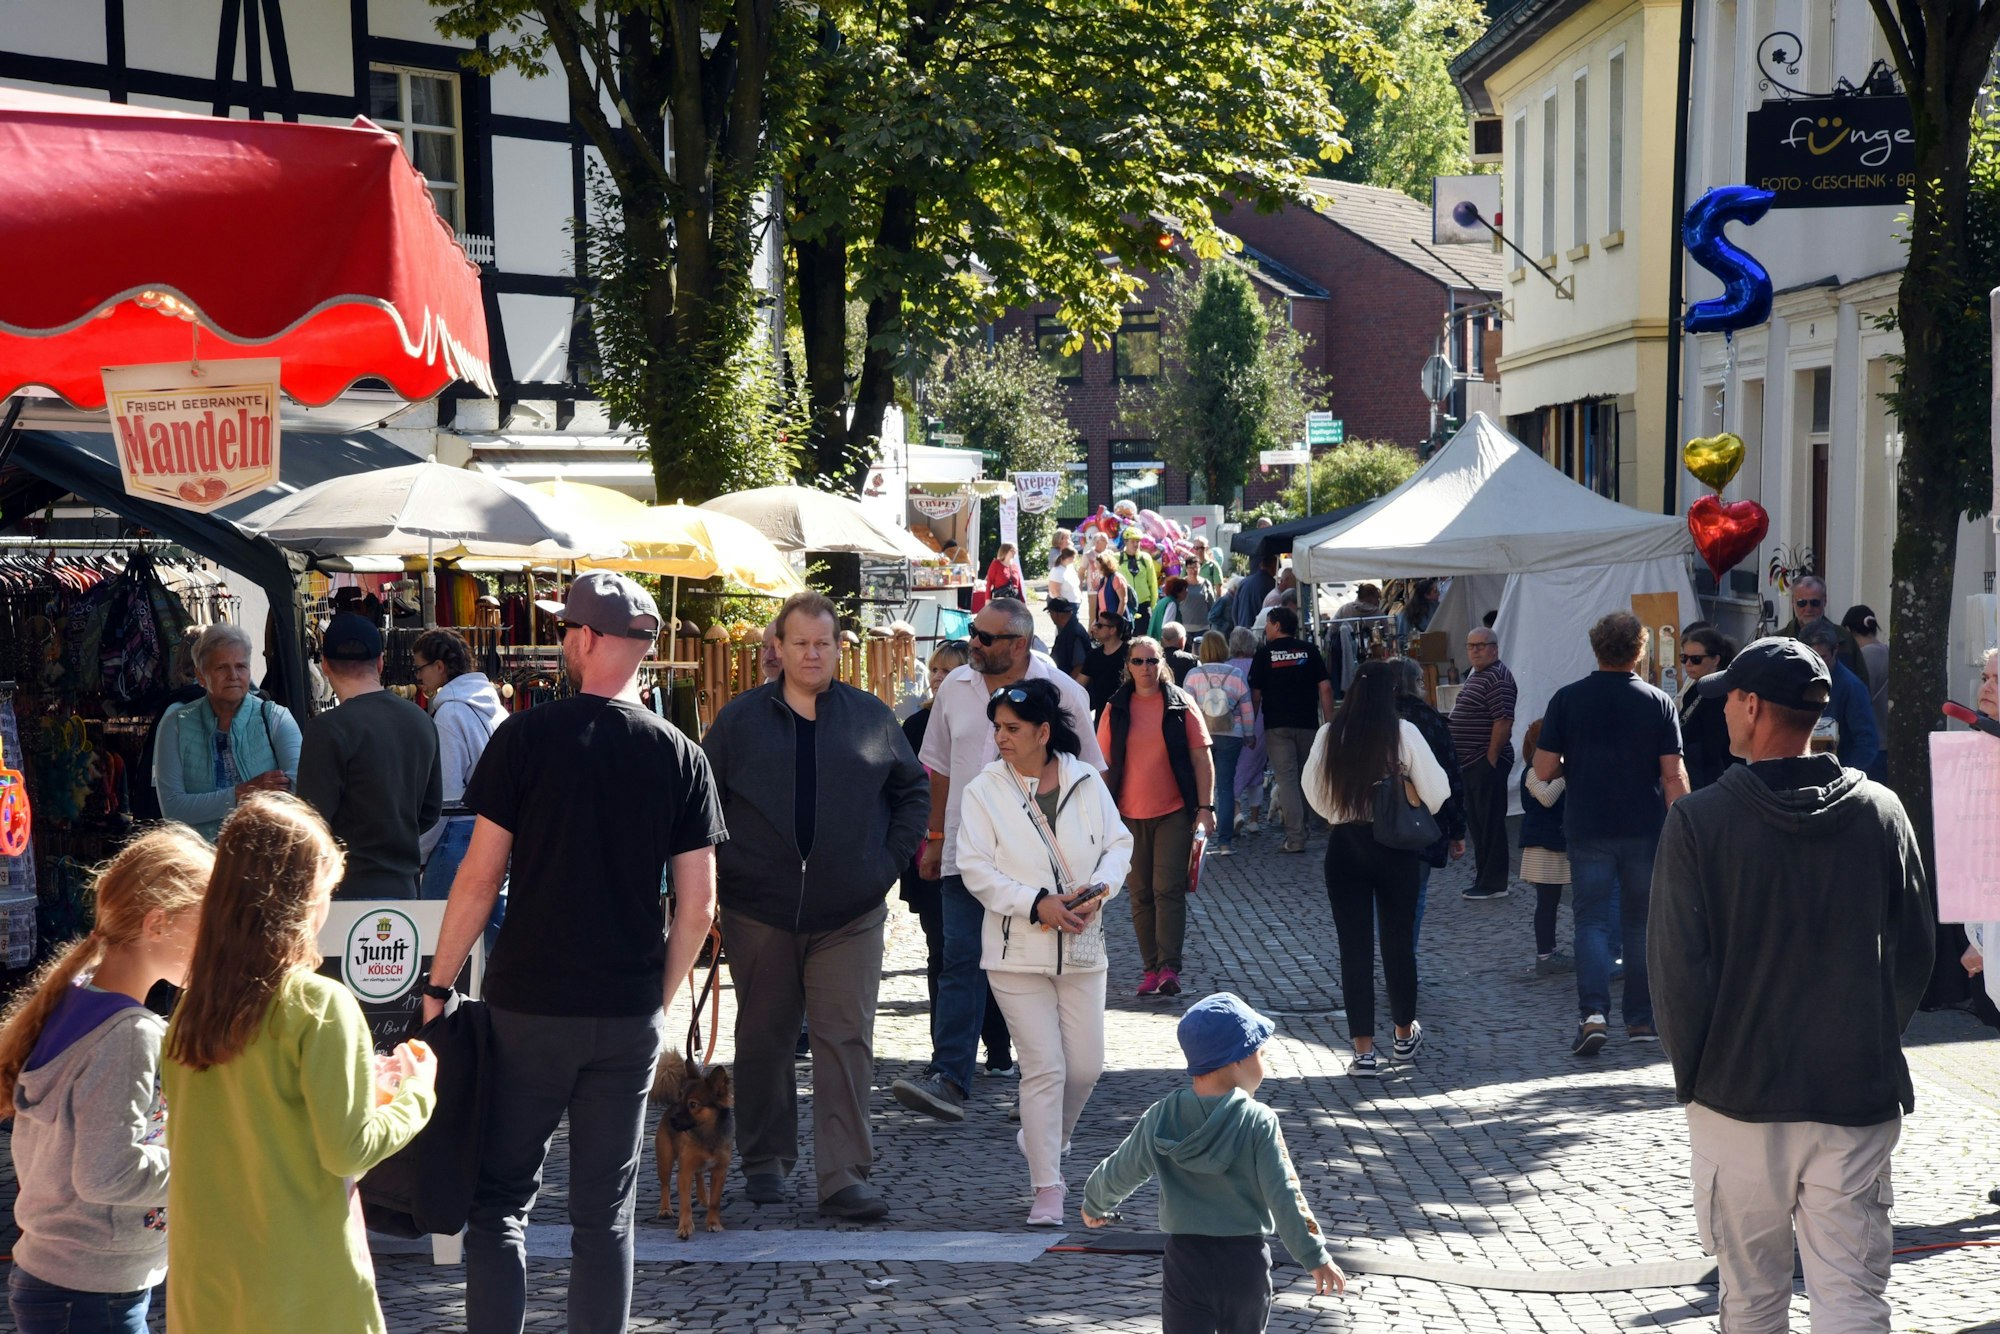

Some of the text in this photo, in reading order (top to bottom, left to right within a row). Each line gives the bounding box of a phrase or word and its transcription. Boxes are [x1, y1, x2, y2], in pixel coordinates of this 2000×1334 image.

[1761, 177, 1801, 191] FOTO
[1812, 173, 1886, 190] GESCHENK
[126, 395, 263, 413] FRISCH GEBRANNTE
[117, 408, 272, 475] Mandeln
[1271, 652, 1308, 661] SUZUKI
[355, 937, 410, 965] Zunft
[368, 963, 403, 975] KÖLSCH
